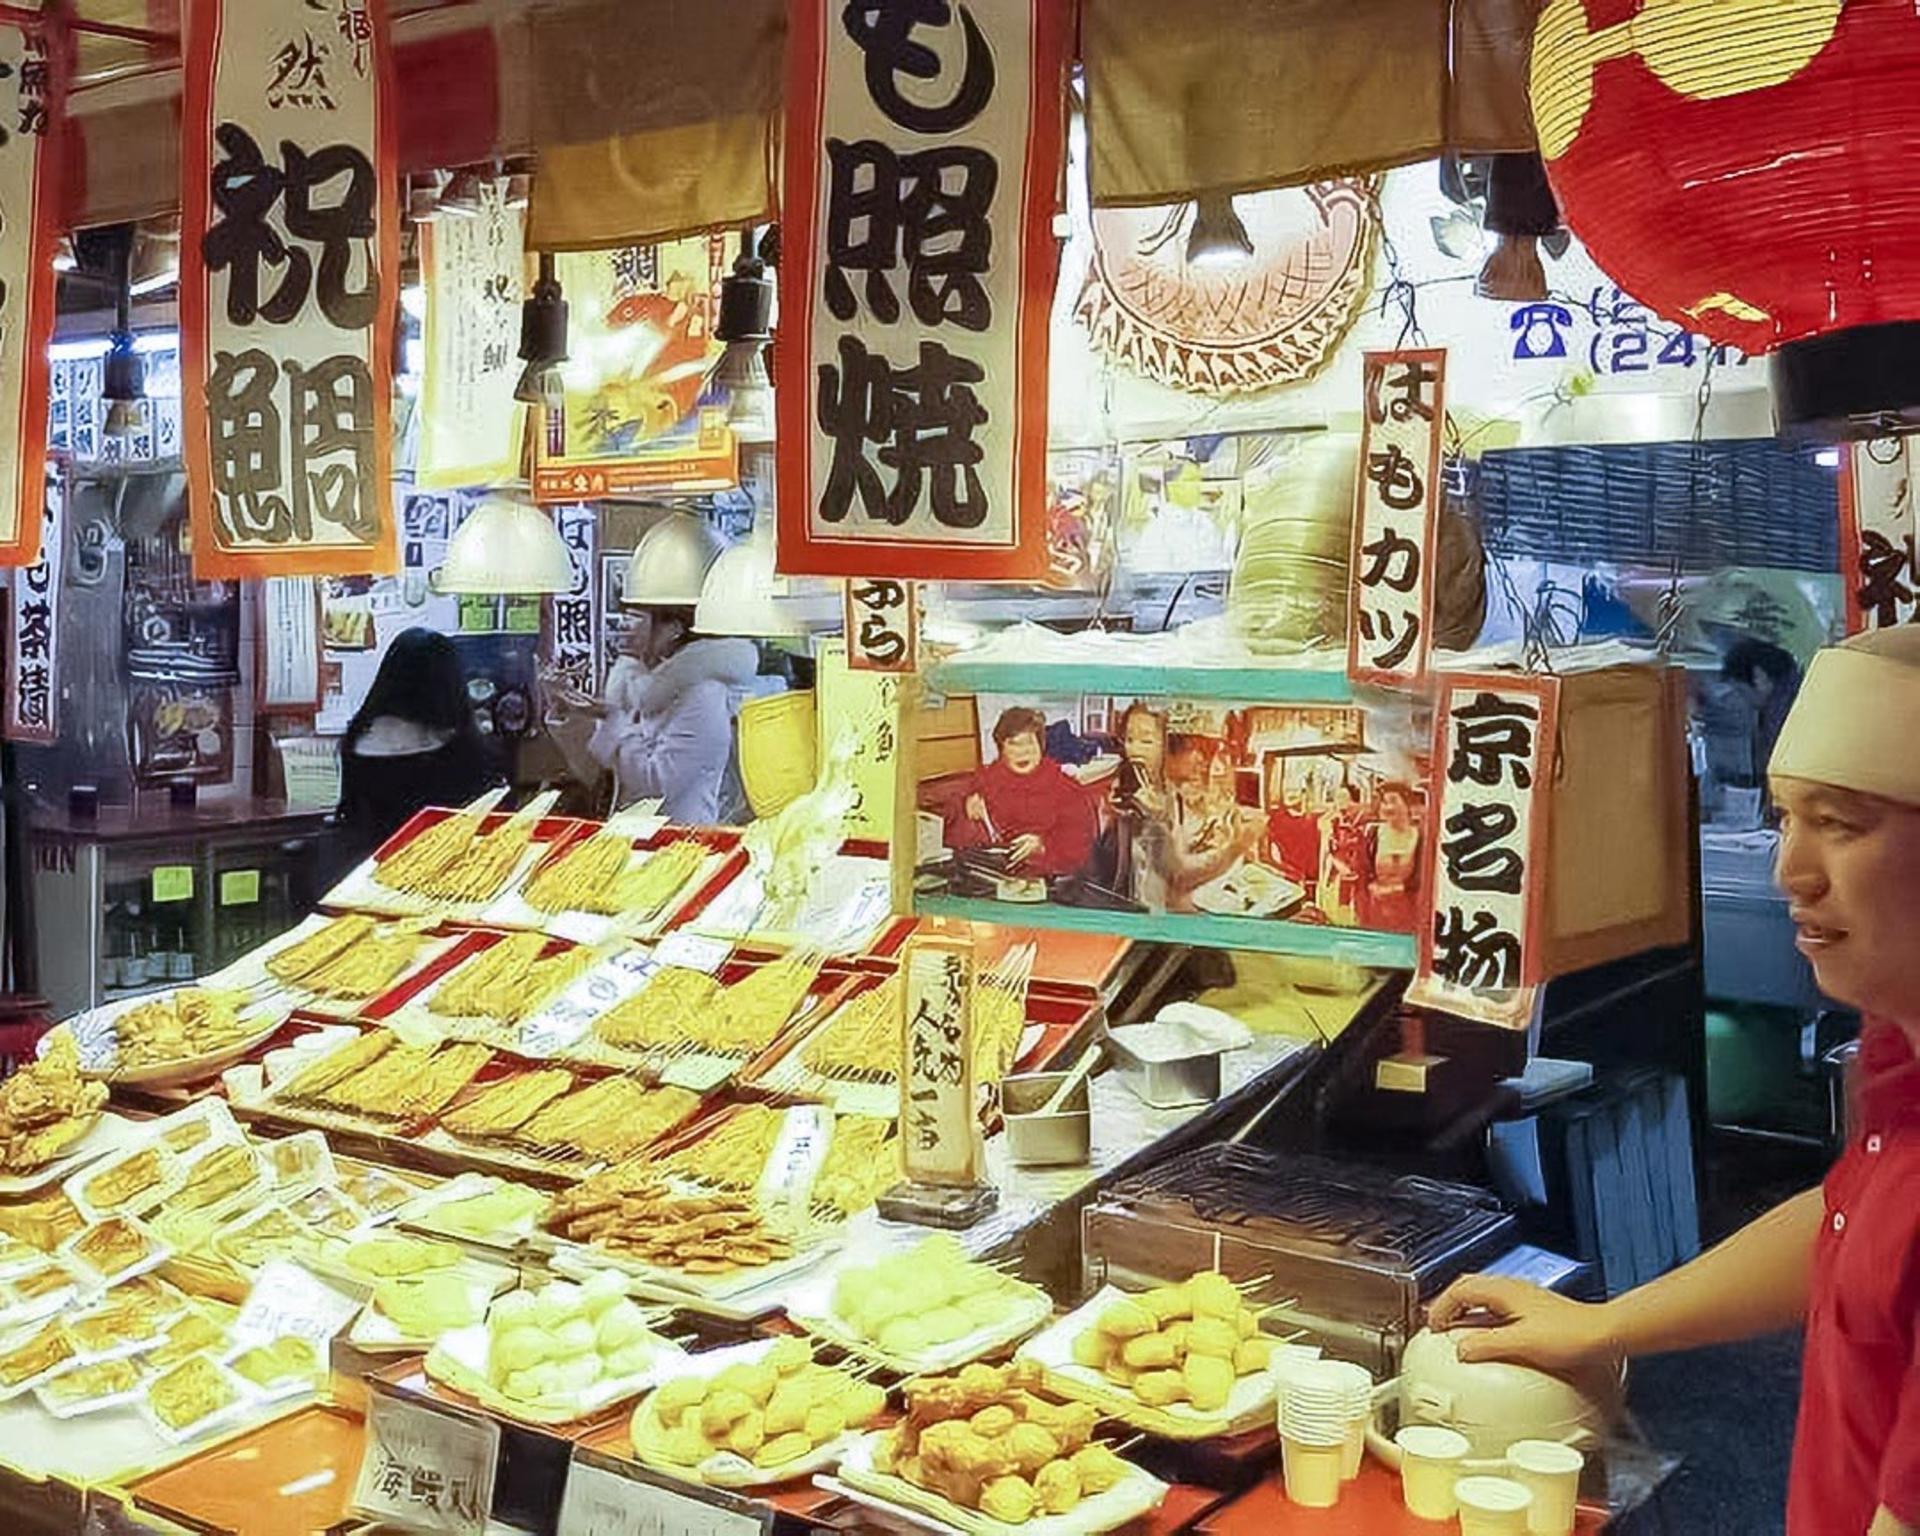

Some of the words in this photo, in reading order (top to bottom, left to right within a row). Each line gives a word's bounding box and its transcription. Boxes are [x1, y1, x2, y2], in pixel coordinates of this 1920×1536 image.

[204, 122, 381, 543] 祝鯛
[818, 0, 999, 528] も照焼
[1361, 364, 1437, 670] はもカツ
[1432, 692, 1539, 990] 京名物
